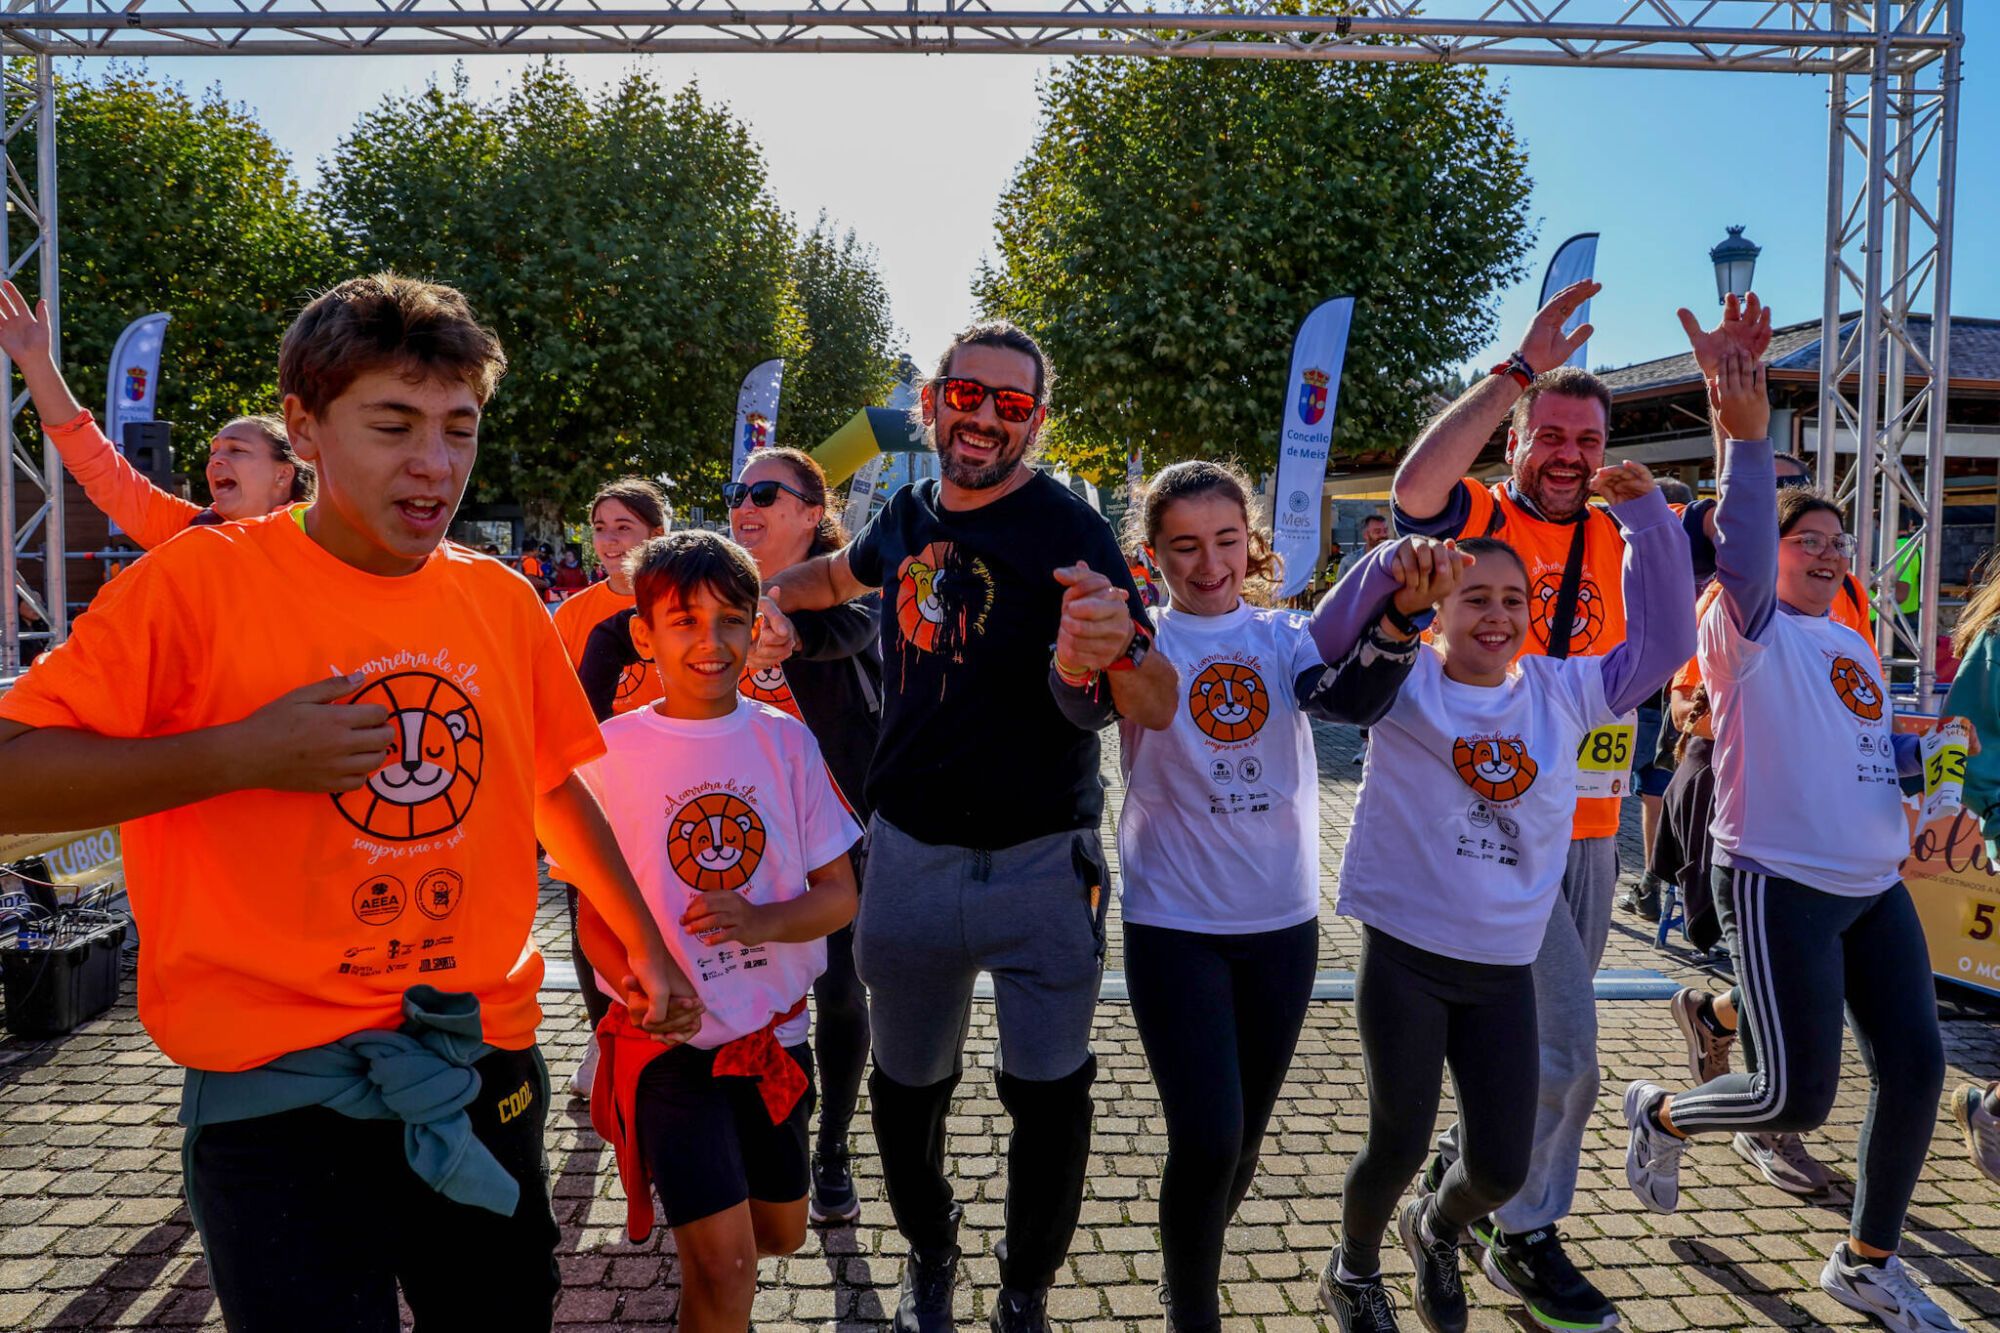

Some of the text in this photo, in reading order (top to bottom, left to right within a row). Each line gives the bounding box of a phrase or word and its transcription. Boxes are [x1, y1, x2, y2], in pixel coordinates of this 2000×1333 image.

[1287, 429, 1329, 444] Concello
[1287, 445, 1326, 460] de Meis
[1281, 512, 1311, 528] Meis
[1232, 651, 1244, 663] de
[433, 648, 453, 672] de
[453, 663, 481, 697] Leo
[664, 778, 759, 818] A carreira de Leo
[352, 838, 405, 865] sempre
[447, 823, 465, 848] sol
[43, 830, 116, 880] TUBRO
[1940, 876, 1986, 892] DESTINADOS
[361, 895, 399, 909] AEEA
[1958, 956, 1972, 972] O
[498, 1081, 533, 1123] COOL
